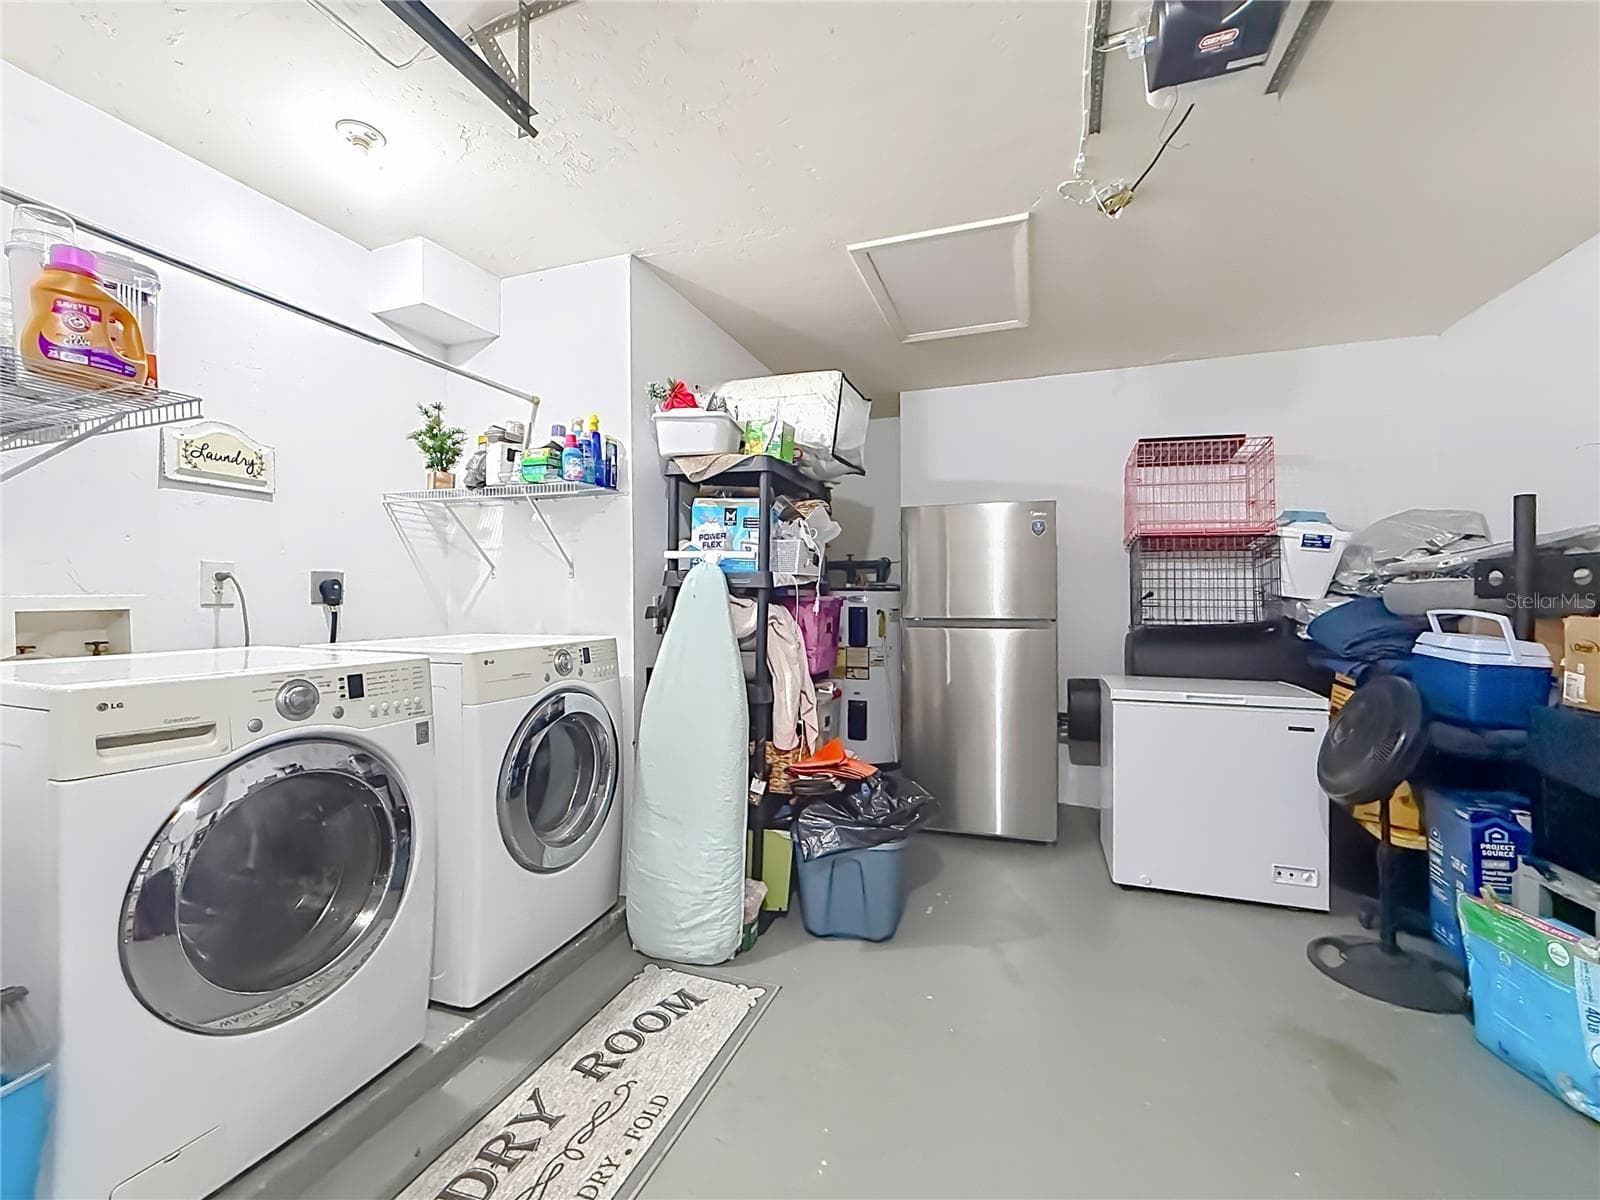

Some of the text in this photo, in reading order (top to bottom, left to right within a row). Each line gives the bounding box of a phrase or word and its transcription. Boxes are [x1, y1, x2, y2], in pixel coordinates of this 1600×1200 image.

[190, 443, 257, 475] Laundry
[699, 532, 727, 541] POWER
[702, 541, 722, 549] FLEX
[1480, 843, 1516, 852] PROJECT
[1481, 850, 1515, 858] SOURCE
[433, 988, 709, 1200] DRY ROOM
[576, 1094, 670, 1200] DRY FOLD
